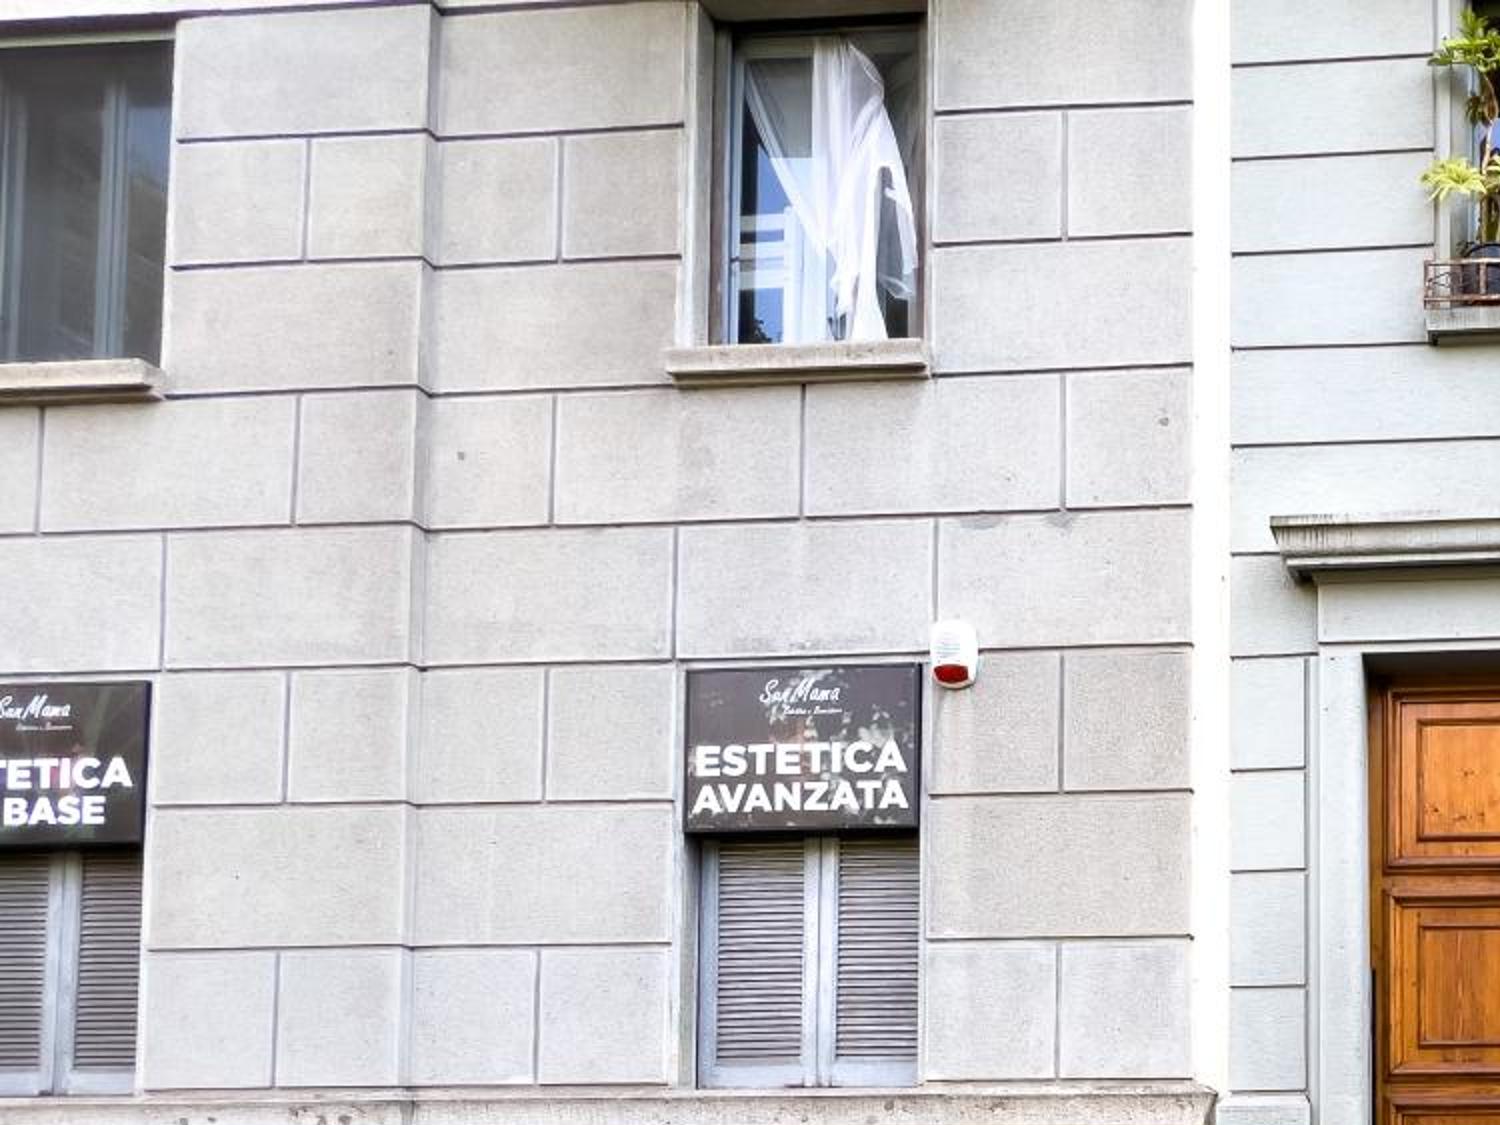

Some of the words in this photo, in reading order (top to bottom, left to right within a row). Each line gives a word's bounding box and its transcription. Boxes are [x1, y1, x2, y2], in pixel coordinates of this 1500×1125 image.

[0, 756, 133, 789] ETICA
[695, 737, 908, 776] ESTETICA
[3, 795, 106, 825] BASE
[691, 779, 909, 812] AVANZATA
